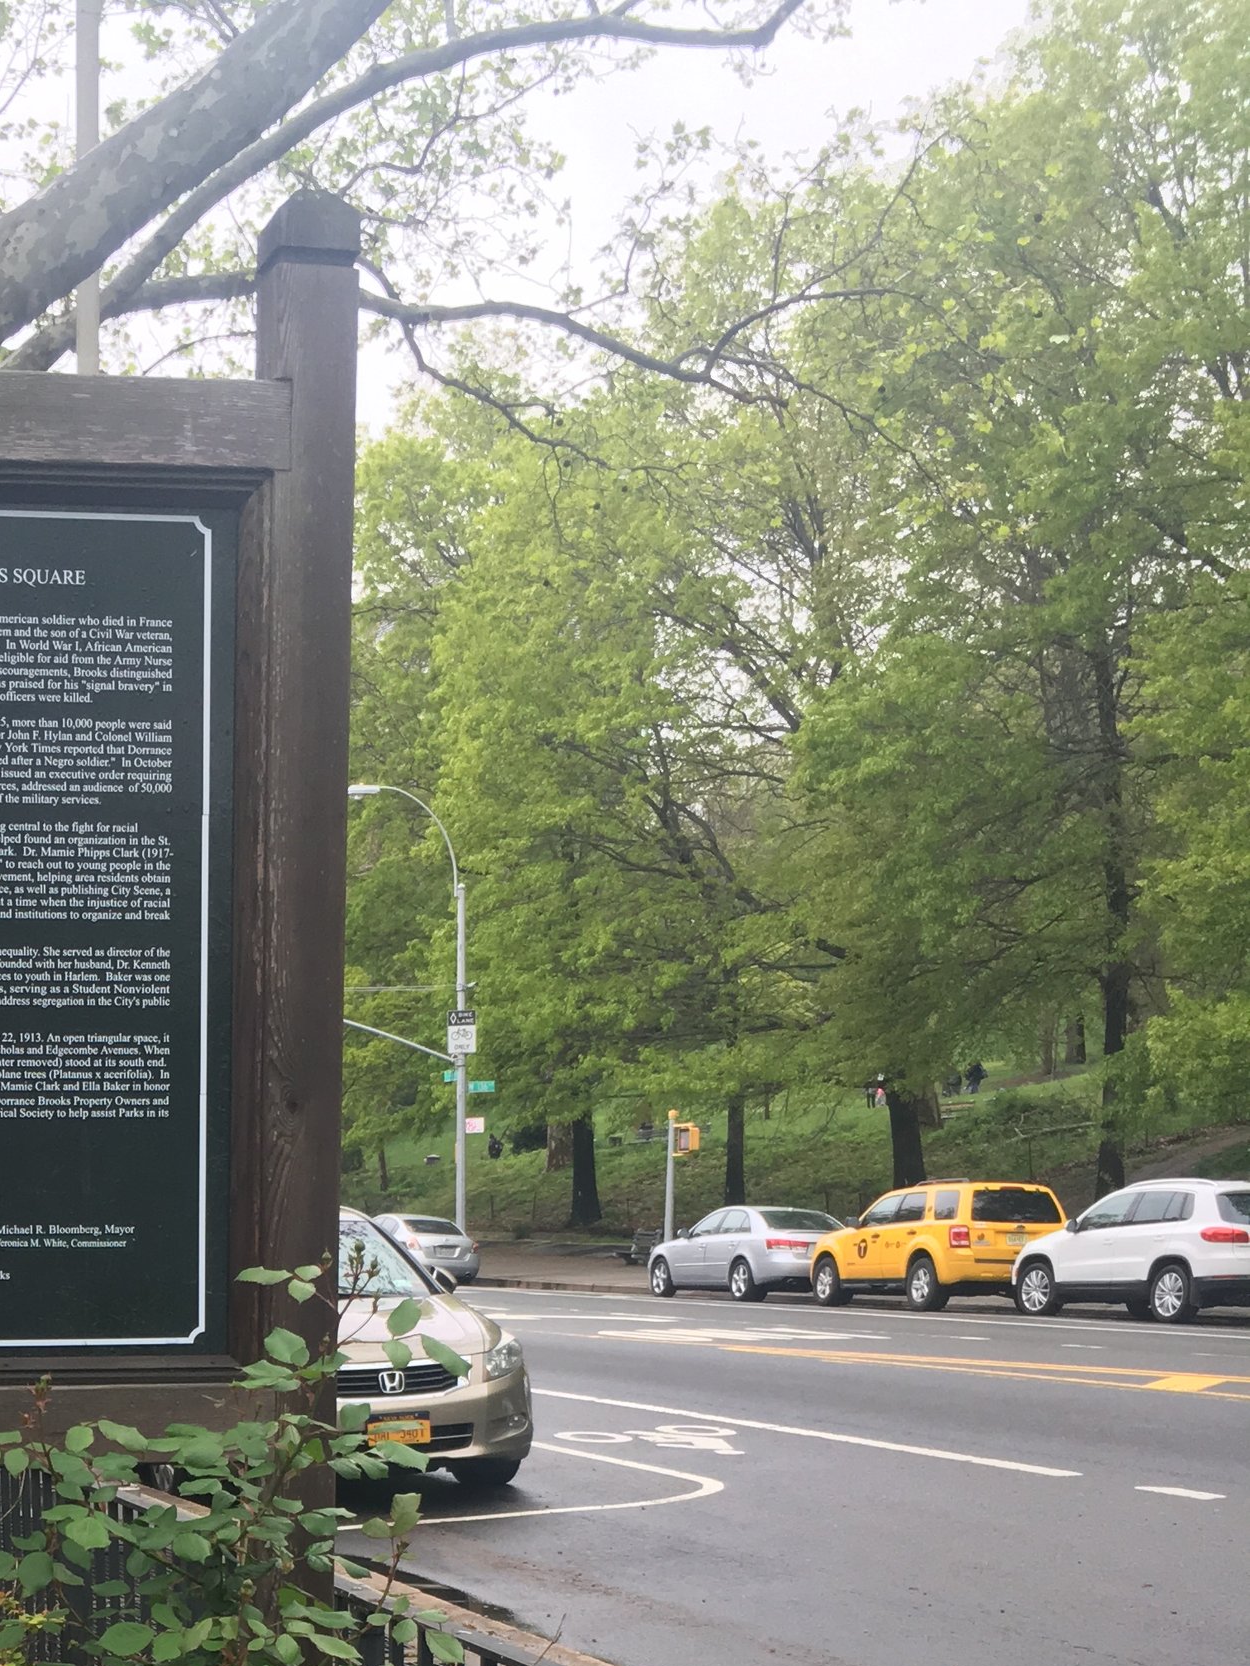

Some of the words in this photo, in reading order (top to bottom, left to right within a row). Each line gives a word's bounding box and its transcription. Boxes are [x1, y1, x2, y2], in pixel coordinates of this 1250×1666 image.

[13, 568, 85, 588] SQUARE
[41, 613, 76, 625] soldier
[78, 614, 99, 626] who
[102, 615, 124, 626] died
[126, 616, 136, 626] in
[139, 616, 172, 627] France
[73, 666, 107, 677] Brooks
[109, 666, 172, 680] distinguished
[11, 719, 36, 727] more
[38, 717, 58, 727] than
[62, 717, 93, 729] 10,000
[95, 718, 126, 730] people
[128, 721, 150, 729] were
[153, 719, 171, 729] said
[0, 767, 31, 778] issued
[34, 770, 46, 778] an
[48, 767, 96, 779] executive
[98, 769, 125, 780] order
[127, 769, 171, 781] requiring
[8, 820, 40, 831] central
[42, 822, 52, 831] to
[54, 821, 69, 832] the
[71, 821, 93, 833] fight
[96, 821, 110, 832] for
[112, 822, 137, 832] racial
[14, 908, 67, 919] institutions
[69, 910, 79, 919] to
[81, 908, 122, 920] organize
[124, 909, 141, 919] and
[144, 909, 170, 920] break
[9, 981, 47, 994] serving
[49, 985, 60, 993] as
[63, 985, 69, 993] a
[72, 983, 111, 994] Student
[113, 983, 170, 994] Nonviolent
[1, 1032, 16, 1043] 22,
[19, 1032, 44, 1042] 1913.
[46, 1033, 60, 1042] An
[62, 1035, 84, 1043] open
[87, 1032, 131, 1043] triangular
[133, 1035, 160, 1043] space,
[163, 1032, 169, 1042] it
[35, 1224, 46, 1234] R.
[48, 1224, 102, 1236] Bloomberg,
[104, 1224, 134, 1235] Mayor
[30, 1238, 41, 1247] M.
[43, 1237, 69, 1248] White,
[70, 1237, 126, 1247] Commissioner
